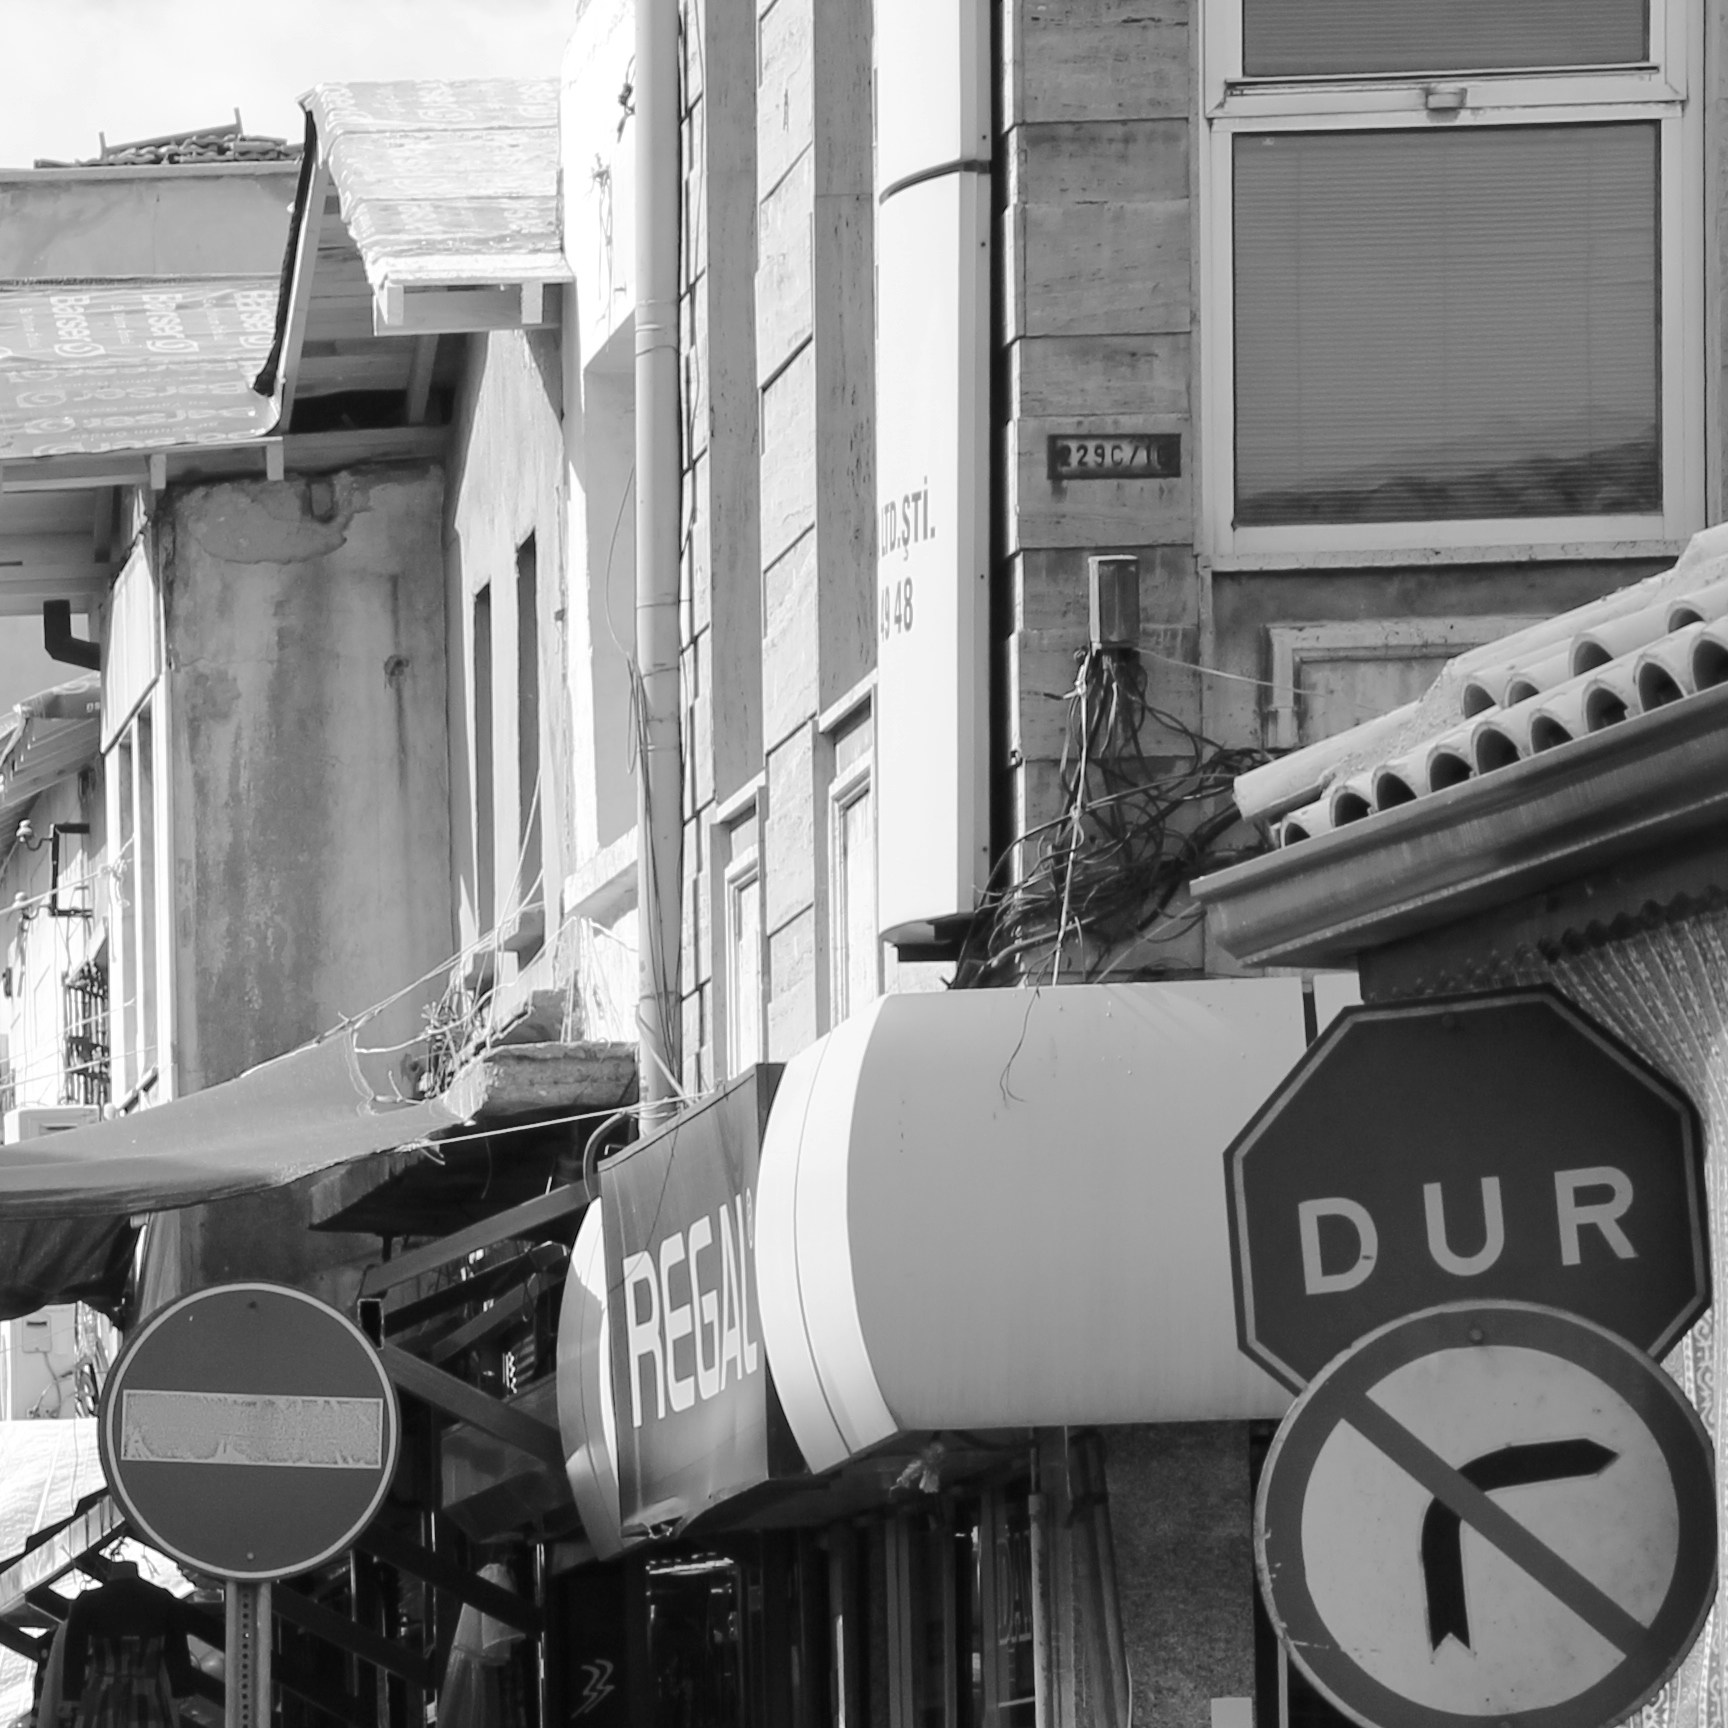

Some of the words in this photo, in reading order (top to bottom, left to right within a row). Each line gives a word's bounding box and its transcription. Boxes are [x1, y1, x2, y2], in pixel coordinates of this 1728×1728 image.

[893, 577, 914, 634] 48
[1298, 1165, 1639, 1296] DUR
[623, 1195, 757, 1428] REGAL
